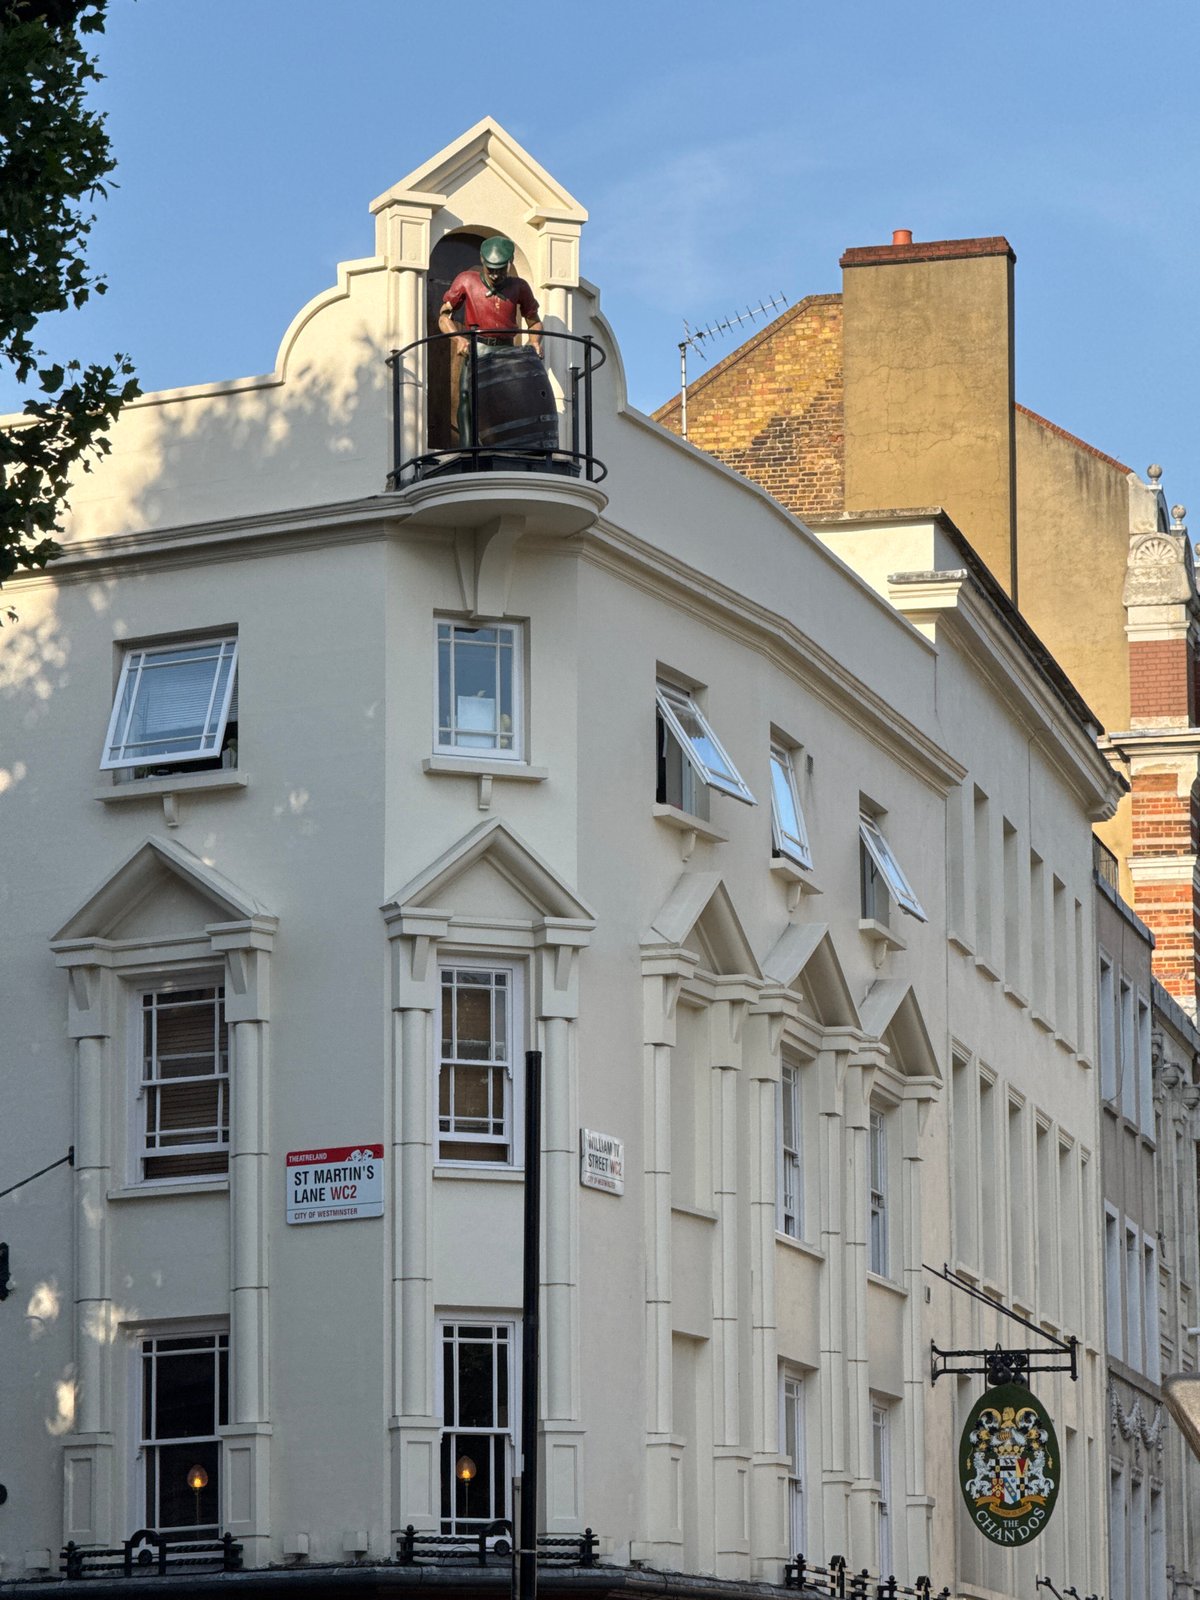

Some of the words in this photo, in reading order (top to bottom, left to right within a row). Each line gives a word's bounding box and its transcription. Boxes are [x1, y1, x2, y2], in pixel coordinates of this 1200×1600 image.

[588, 1136, 612, 1155] WILLIAM
[288, 1152, 327, 1163] THEATRELAND
[588, 1153, 608, 1172] STREET
[610, 1159, 621, 1176] WC2
[294, 1171, 309, 1186] ST
[314, 1165, 374, 1184] MARTIN'S
[294, 1187, 326, 1204] LANE
[330, 1184, 357, 1201] WC2
[294, 1211, 307, 1220] CITY
[309, 1211, 316, 1219] OF
[318, 1207, 358, 1218] WESTMINSTER
[976, 1507, 1046, 1542] CHANDOS
[1003, 1520, 1020, 1528] THE
